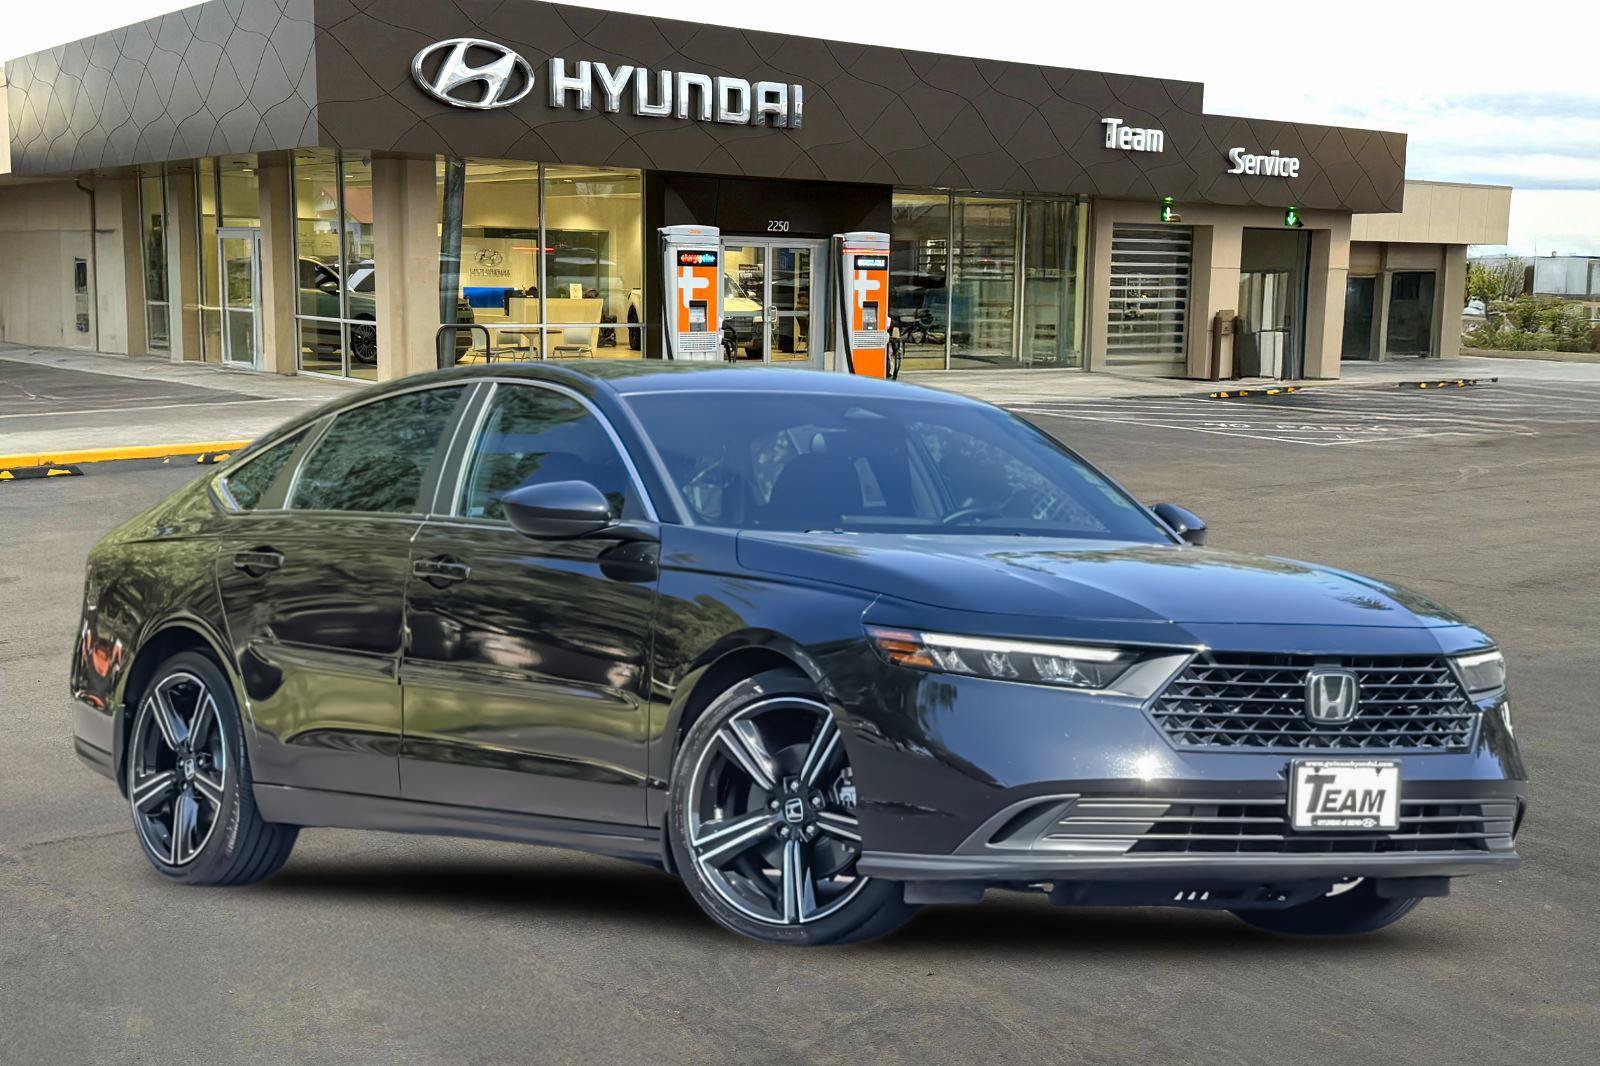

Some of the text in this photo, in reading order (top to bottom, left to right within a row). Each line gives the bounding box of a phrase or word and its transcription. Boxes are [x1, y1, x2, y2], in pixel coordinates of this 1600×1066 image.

[548, 57, 803, 129] HYUNDAI
[1101, 117, 1164, 153] Team
[1227, 147, 1300, 178] Service
[767, 220, 790, 232] 2250
[1304, 774, 1387, 814] TEAM
